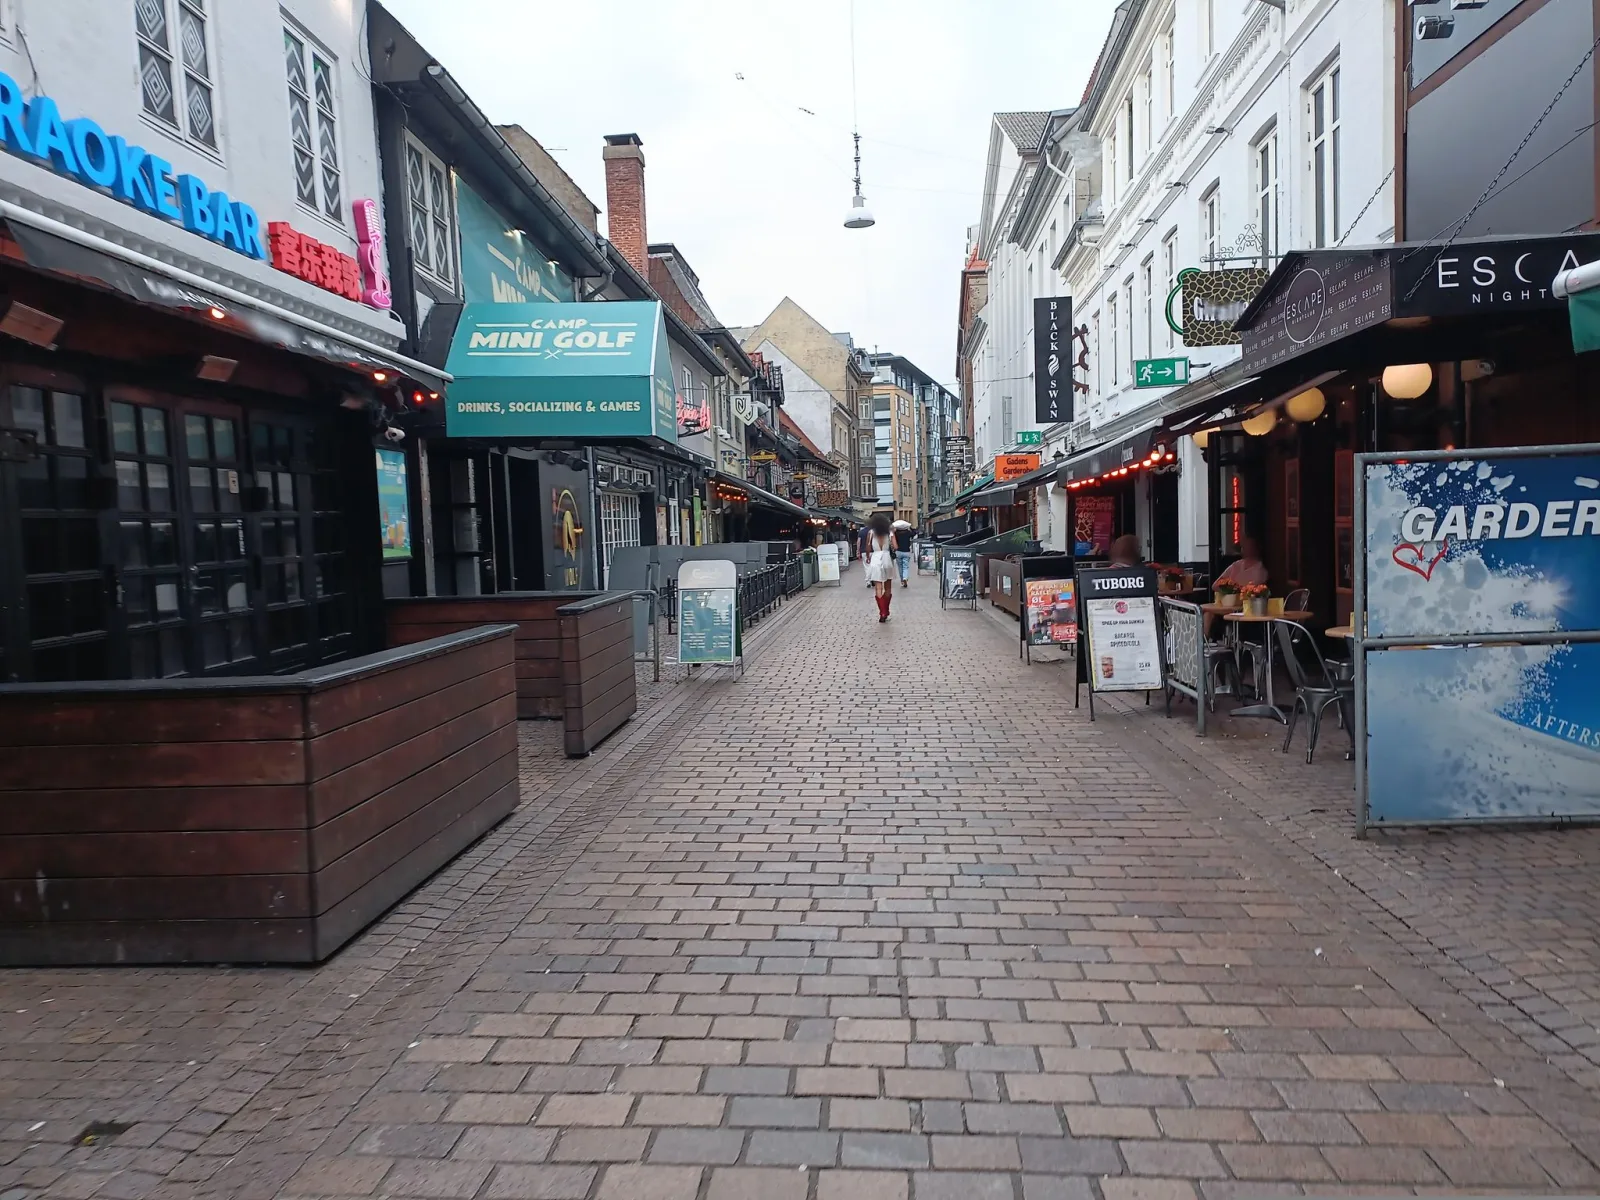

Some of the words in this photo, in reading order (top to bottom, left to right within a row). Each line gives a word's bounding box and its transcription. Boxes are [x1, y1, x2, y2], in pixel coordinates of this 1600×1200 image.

[0, 71, 181, 221] RAOKE
[178, 174, 267, 260] BAR
[516, 256, 540, 297] CAMP
[1354, 264, 1374, 281] ESCAPE
[1329, 279, 1347, 294] ESCAPE
[1362, 282, 1383, 299] ESCAPE
[1286, 288, 1322, 320] ESCAPE
[1338, 295, 1357, 310] ESCAPE
[531, 319, 588, 330] CAMP
[1354, 310, 1375, 325] ESCAPE
[1049, 301, 1059, 351] BLACK
[1330, 322, 1349, 336] ESCAPE
[469, 331, 544, 349] MINI
[553, 331, 637, 349] GOLF
[1048, 379, 1059, 419] SWAN
[457, 402, 505, 415] DRINKS,
[508, 401, 582, 413] SOCIALIZING
[586, 400, 596, 412] &
[600, 401, 641, 412] GAMES
[1006, 457, 1029, 465] Gadens
[1091, 576, 1145, 590] TUBORG
